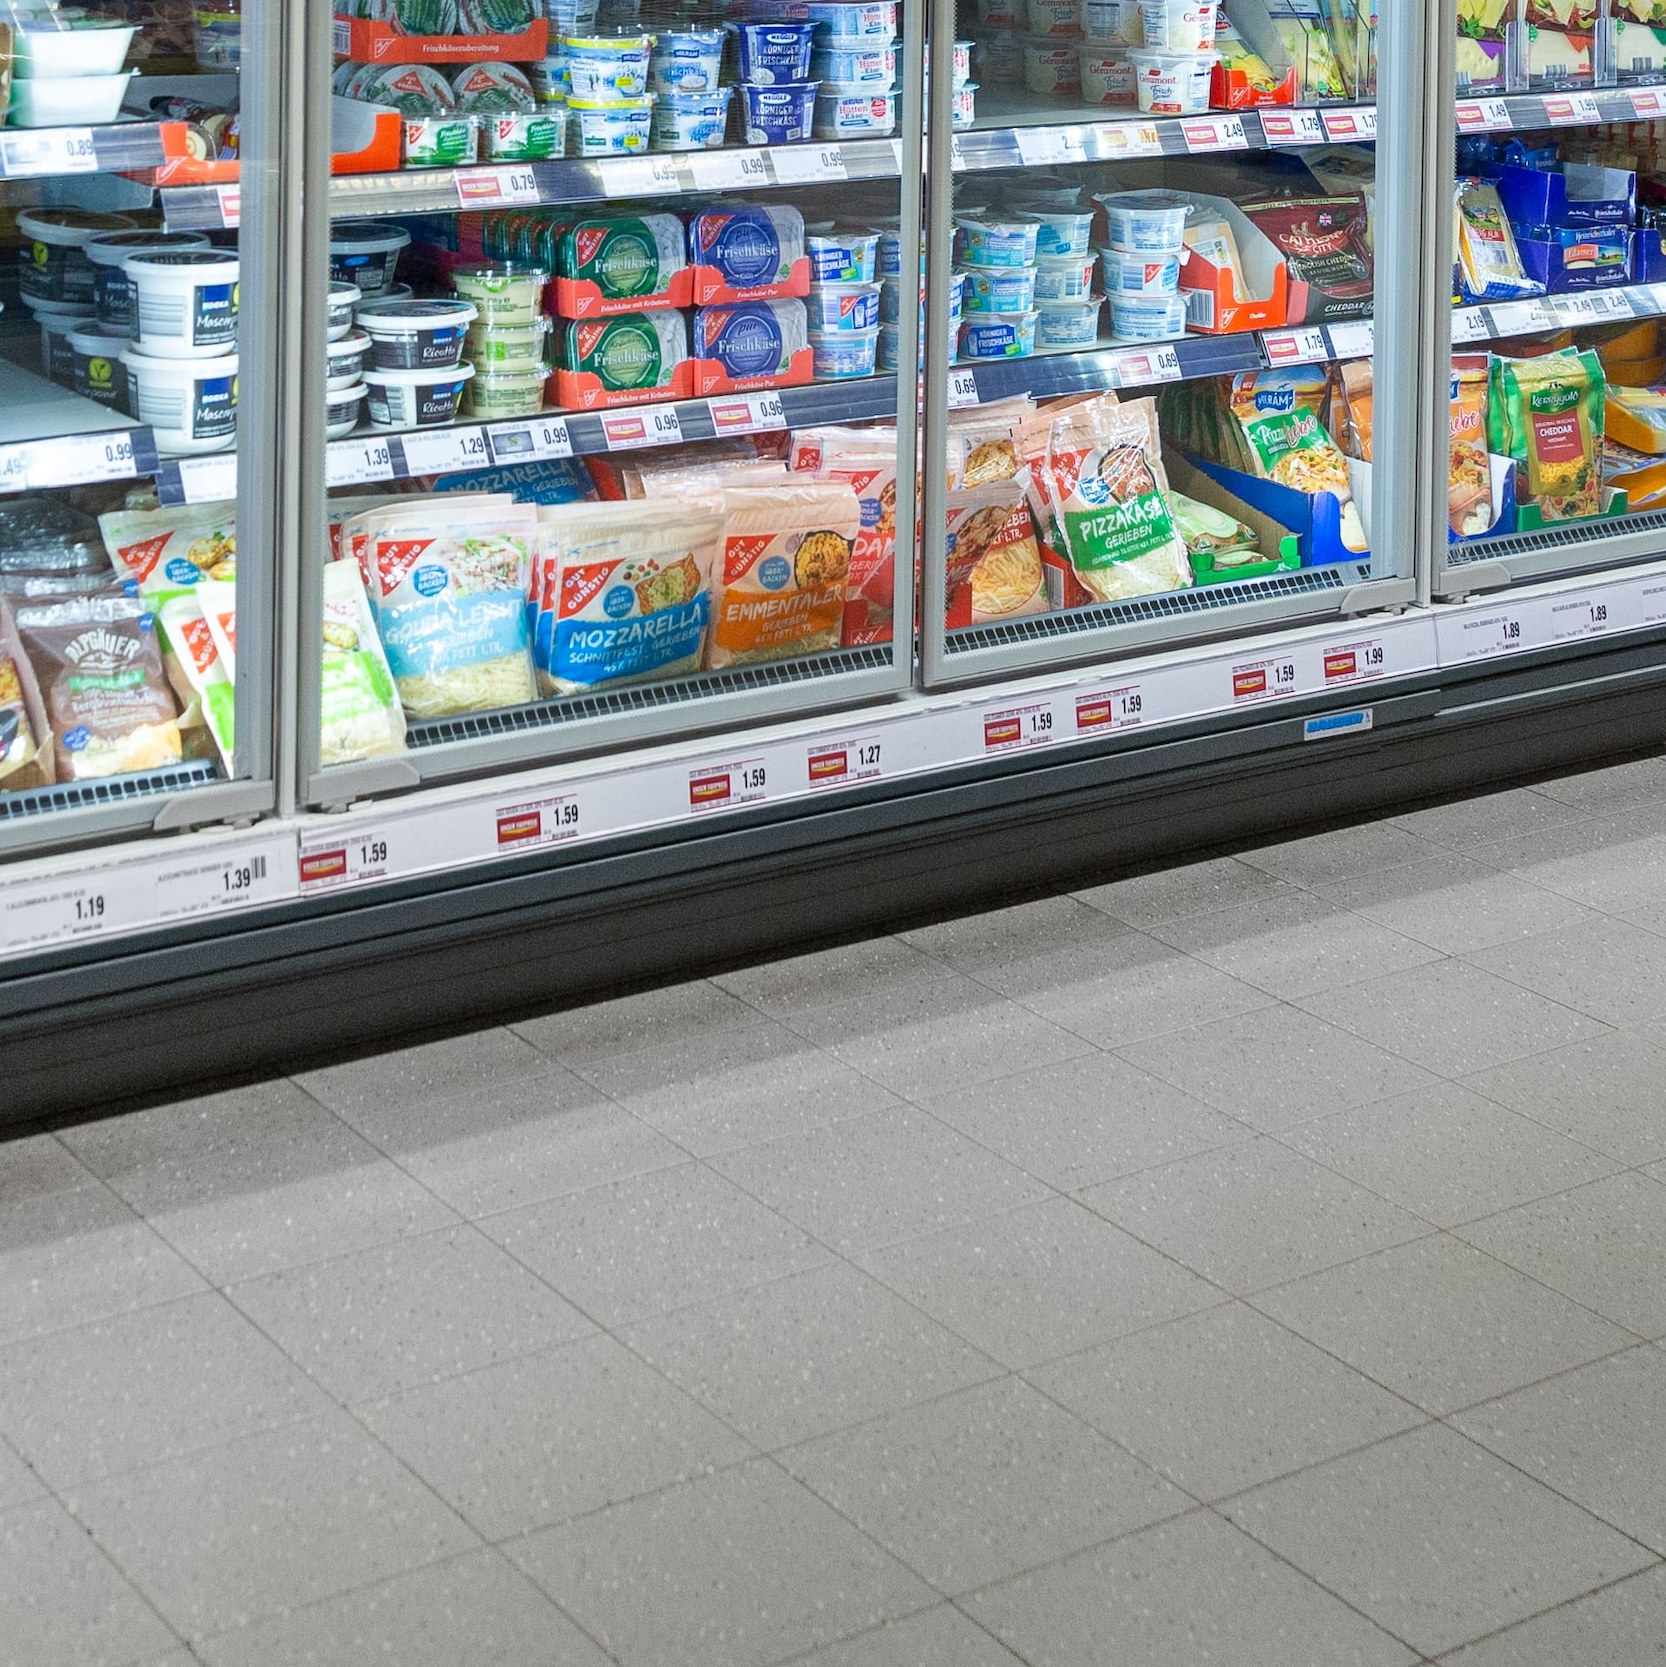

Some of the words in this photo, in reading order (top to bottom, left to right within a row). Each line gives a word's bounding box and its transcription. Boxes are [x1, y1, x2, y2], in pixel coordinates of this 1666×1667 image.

[421, 41, 500, 55] Frischkäsezubereitung
[1138, 72, 1177, 87] Géramont
[1300, 117, 1319, 133] 1.79
[66, 138, 94, 157] 0.89
[716, 245, 778, 260] Frischkäse
[1312, 242, 1333, 254] CITY
[594, 256, 657, 274] Frischkäse
[202, 300, 229, 311] EDEKA
[1325, 302, 1364, 312] CHEDDAR
[738, 323, 760, 334] pur
[423, 343, 458, 361] Ricotta
[718, 338, 780, 353] Frischkäse
[593, 349, 659, 368] Frischkäse
[955, 377, 976, 394] 0.69
[655, 415, 678, 432] 0.96
[1540, 425, 1573, 436] CHEDDAR
[104, 443, 132, 462] 0.99
[459, 437, 485, 457] 1.29
[363, 449, 390, 469] 1.39
[1079, 495, 1163, 543] PIZZAKÄSE
[1105, 525, 1154, 548] GERIEBEN
[566, 567, 613, 612] GÜNSTIG
[726, 584, 844, 621] EMMENTALER
[761, 612, 809, 632] GERIEBEN
[1590, 605, 1607, 623] 1.89
[569, 606, 702, 650] MOZZARELLA
[569, 642, 644, 664] SCHNITTFEST.
[649, 627, 701, 650] GERIEBEN
[1365, 648, 1383, 665] 1.99
[1031, 712, 1052, 732] 1.59
[859, 745, 881, 765] 1.27
[743, 768, 766, 789] 1.59
[554, 805, 579, 826] 1.59
[361, 842, 388, 865] 1.59
[223, 867, 251, 892] 1.39
[75, 895, 105, 919] 1.19
